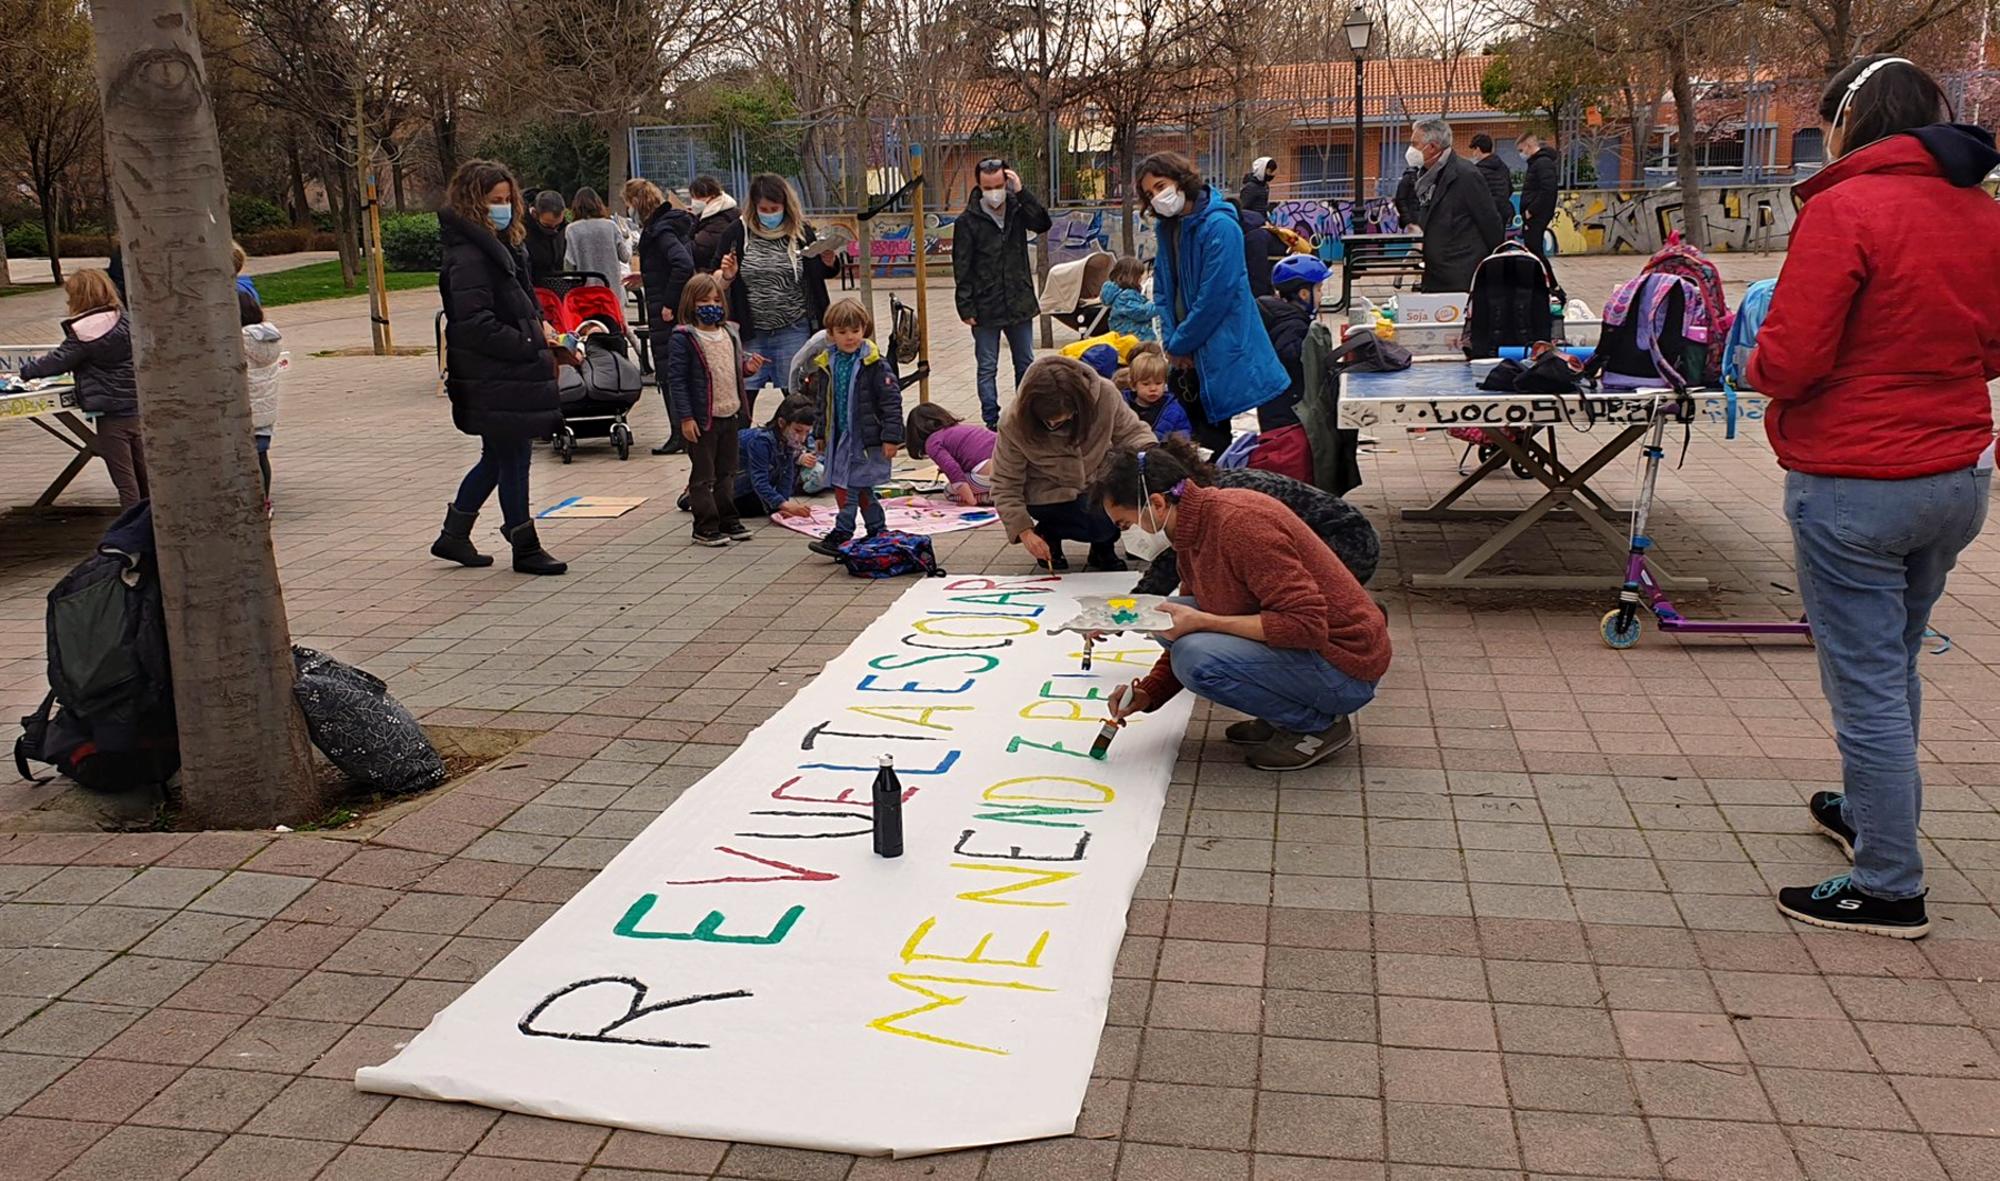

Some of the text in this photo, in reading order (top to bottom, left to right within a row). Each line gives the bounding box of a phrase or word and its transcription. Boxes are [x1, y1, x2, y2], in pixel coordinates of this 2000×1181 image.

[1406, 312, 1428, 323] Soja
[518, 575, 1062, 1049] REVUELTA ESCOLAR
